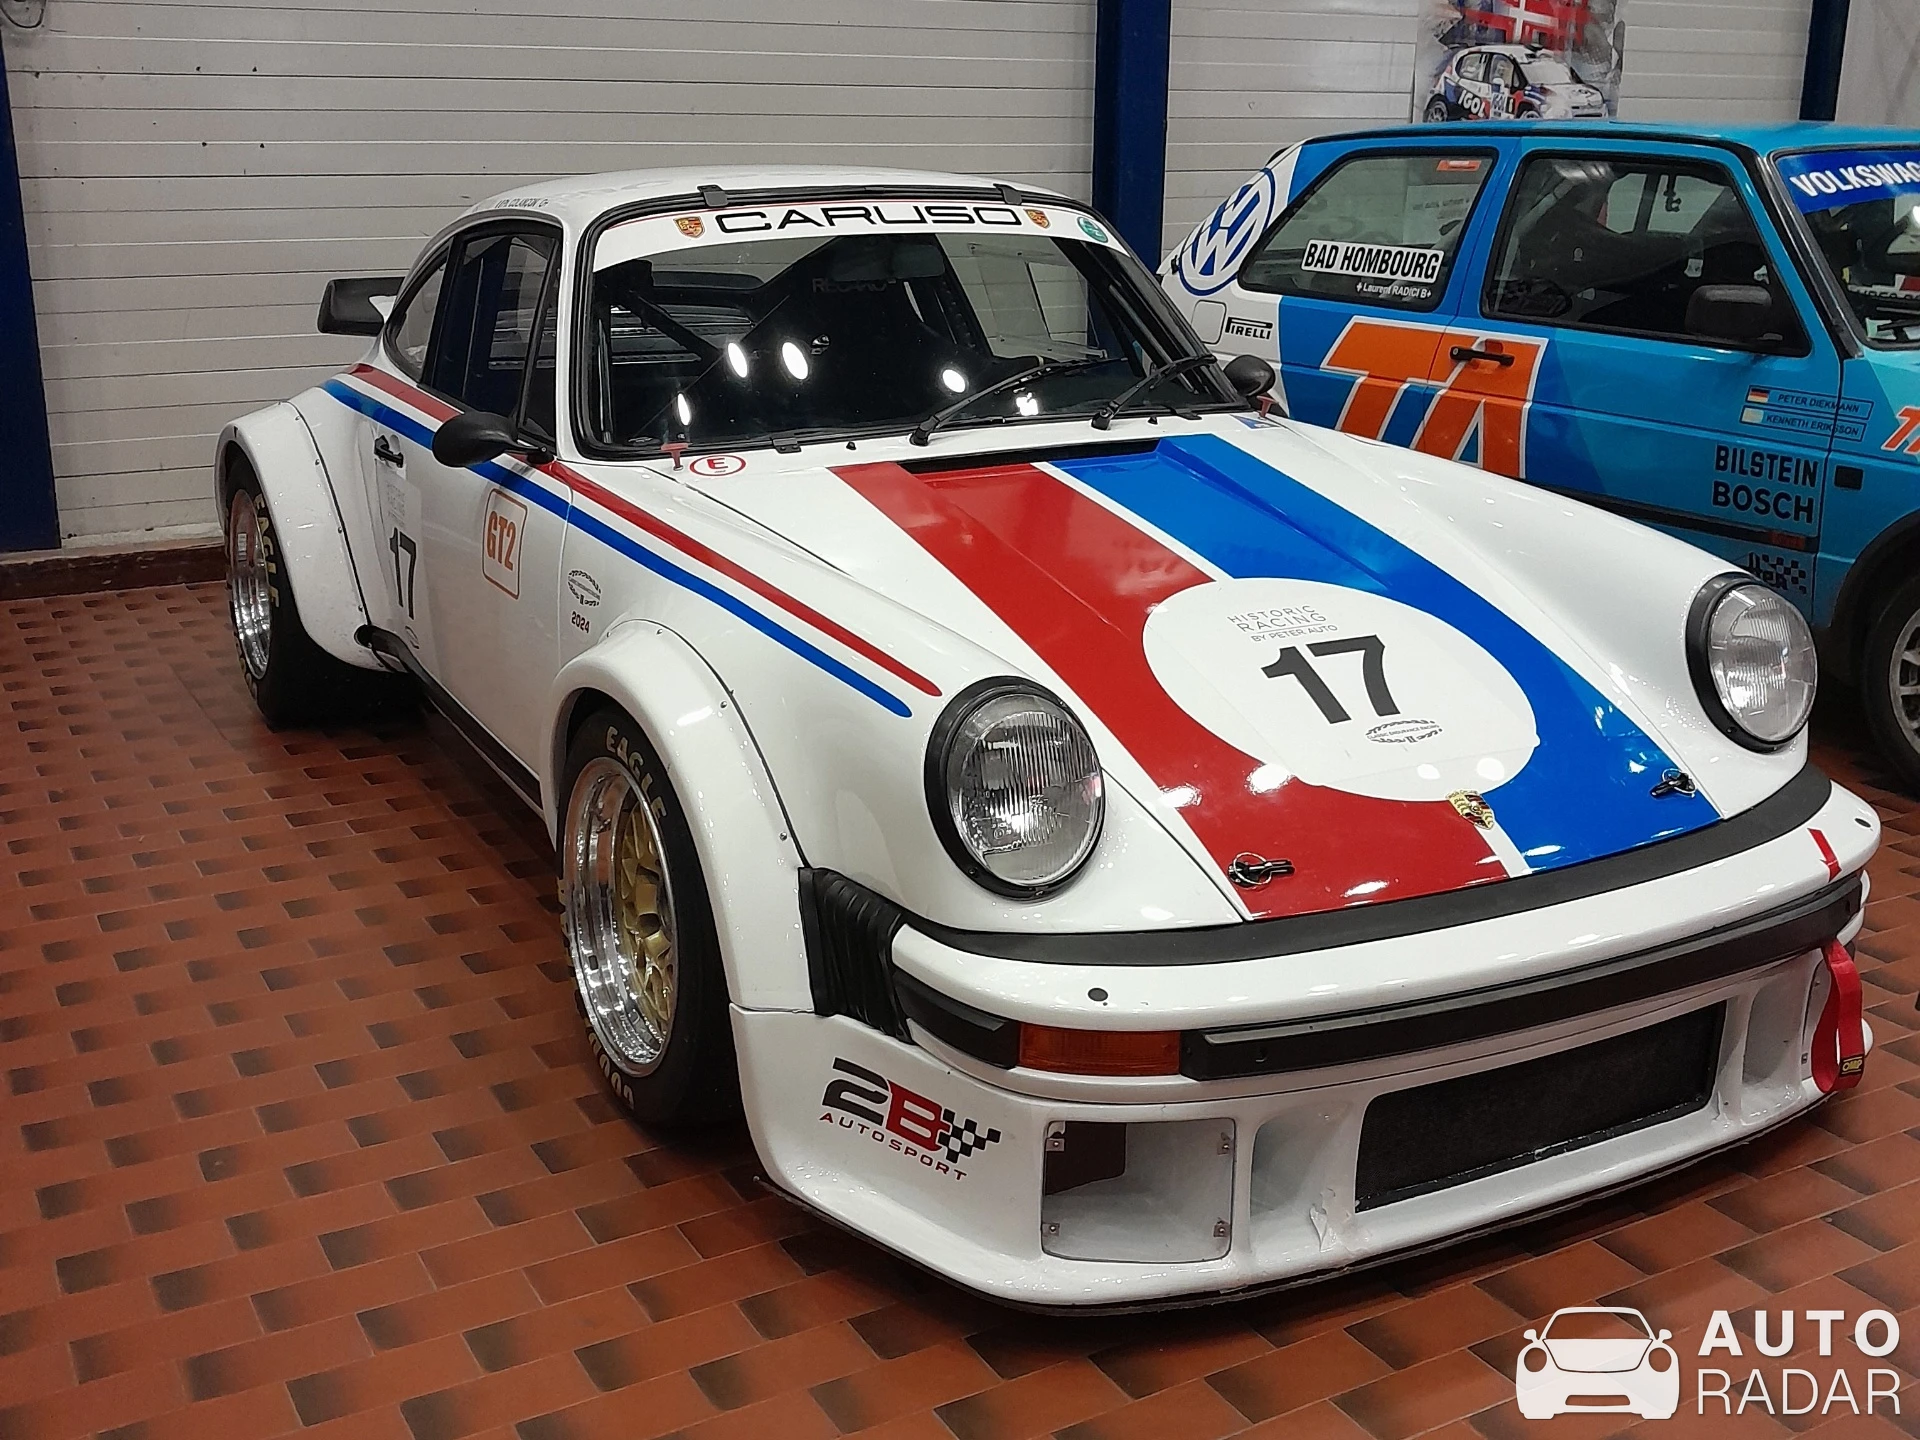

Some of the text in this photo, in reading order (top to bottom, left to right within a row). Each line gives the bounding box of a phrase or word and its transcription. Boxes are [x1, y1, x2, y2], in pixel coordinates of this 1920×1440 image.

[1458, 90, 1486, 117] IGOL
[715, 205, 1023, 234] CARUSO
[1304, 243, 1439, 280] BAD HOMBOURG
[1225, 316, 1273, 340] PIRELLI
[1320, 316, 1549, 479] TA
[1778, 393, 1807, 408] PETER
[1766, 414, 1809, 429] KENNETH
[1715, 444, 1819, 488] BILSTEIN
[1712, 480, 1814, 524] BOSCH
[487, 510, 516, 571] GT2
[389, 526, 417, 620] 17
[571, 611, 590, 634] 2024
[1227, 605, 1315, 623] HISTORIC
[1236, 612, 1327, 632] RACING
[1250, 624, 1338, 642] BY PETER AUTO
[1260, 634, 1401, 725] 17
[606, 726, 668, 822] EAGLE
[819, 1112, 968, 1181] AUTOSPORT
